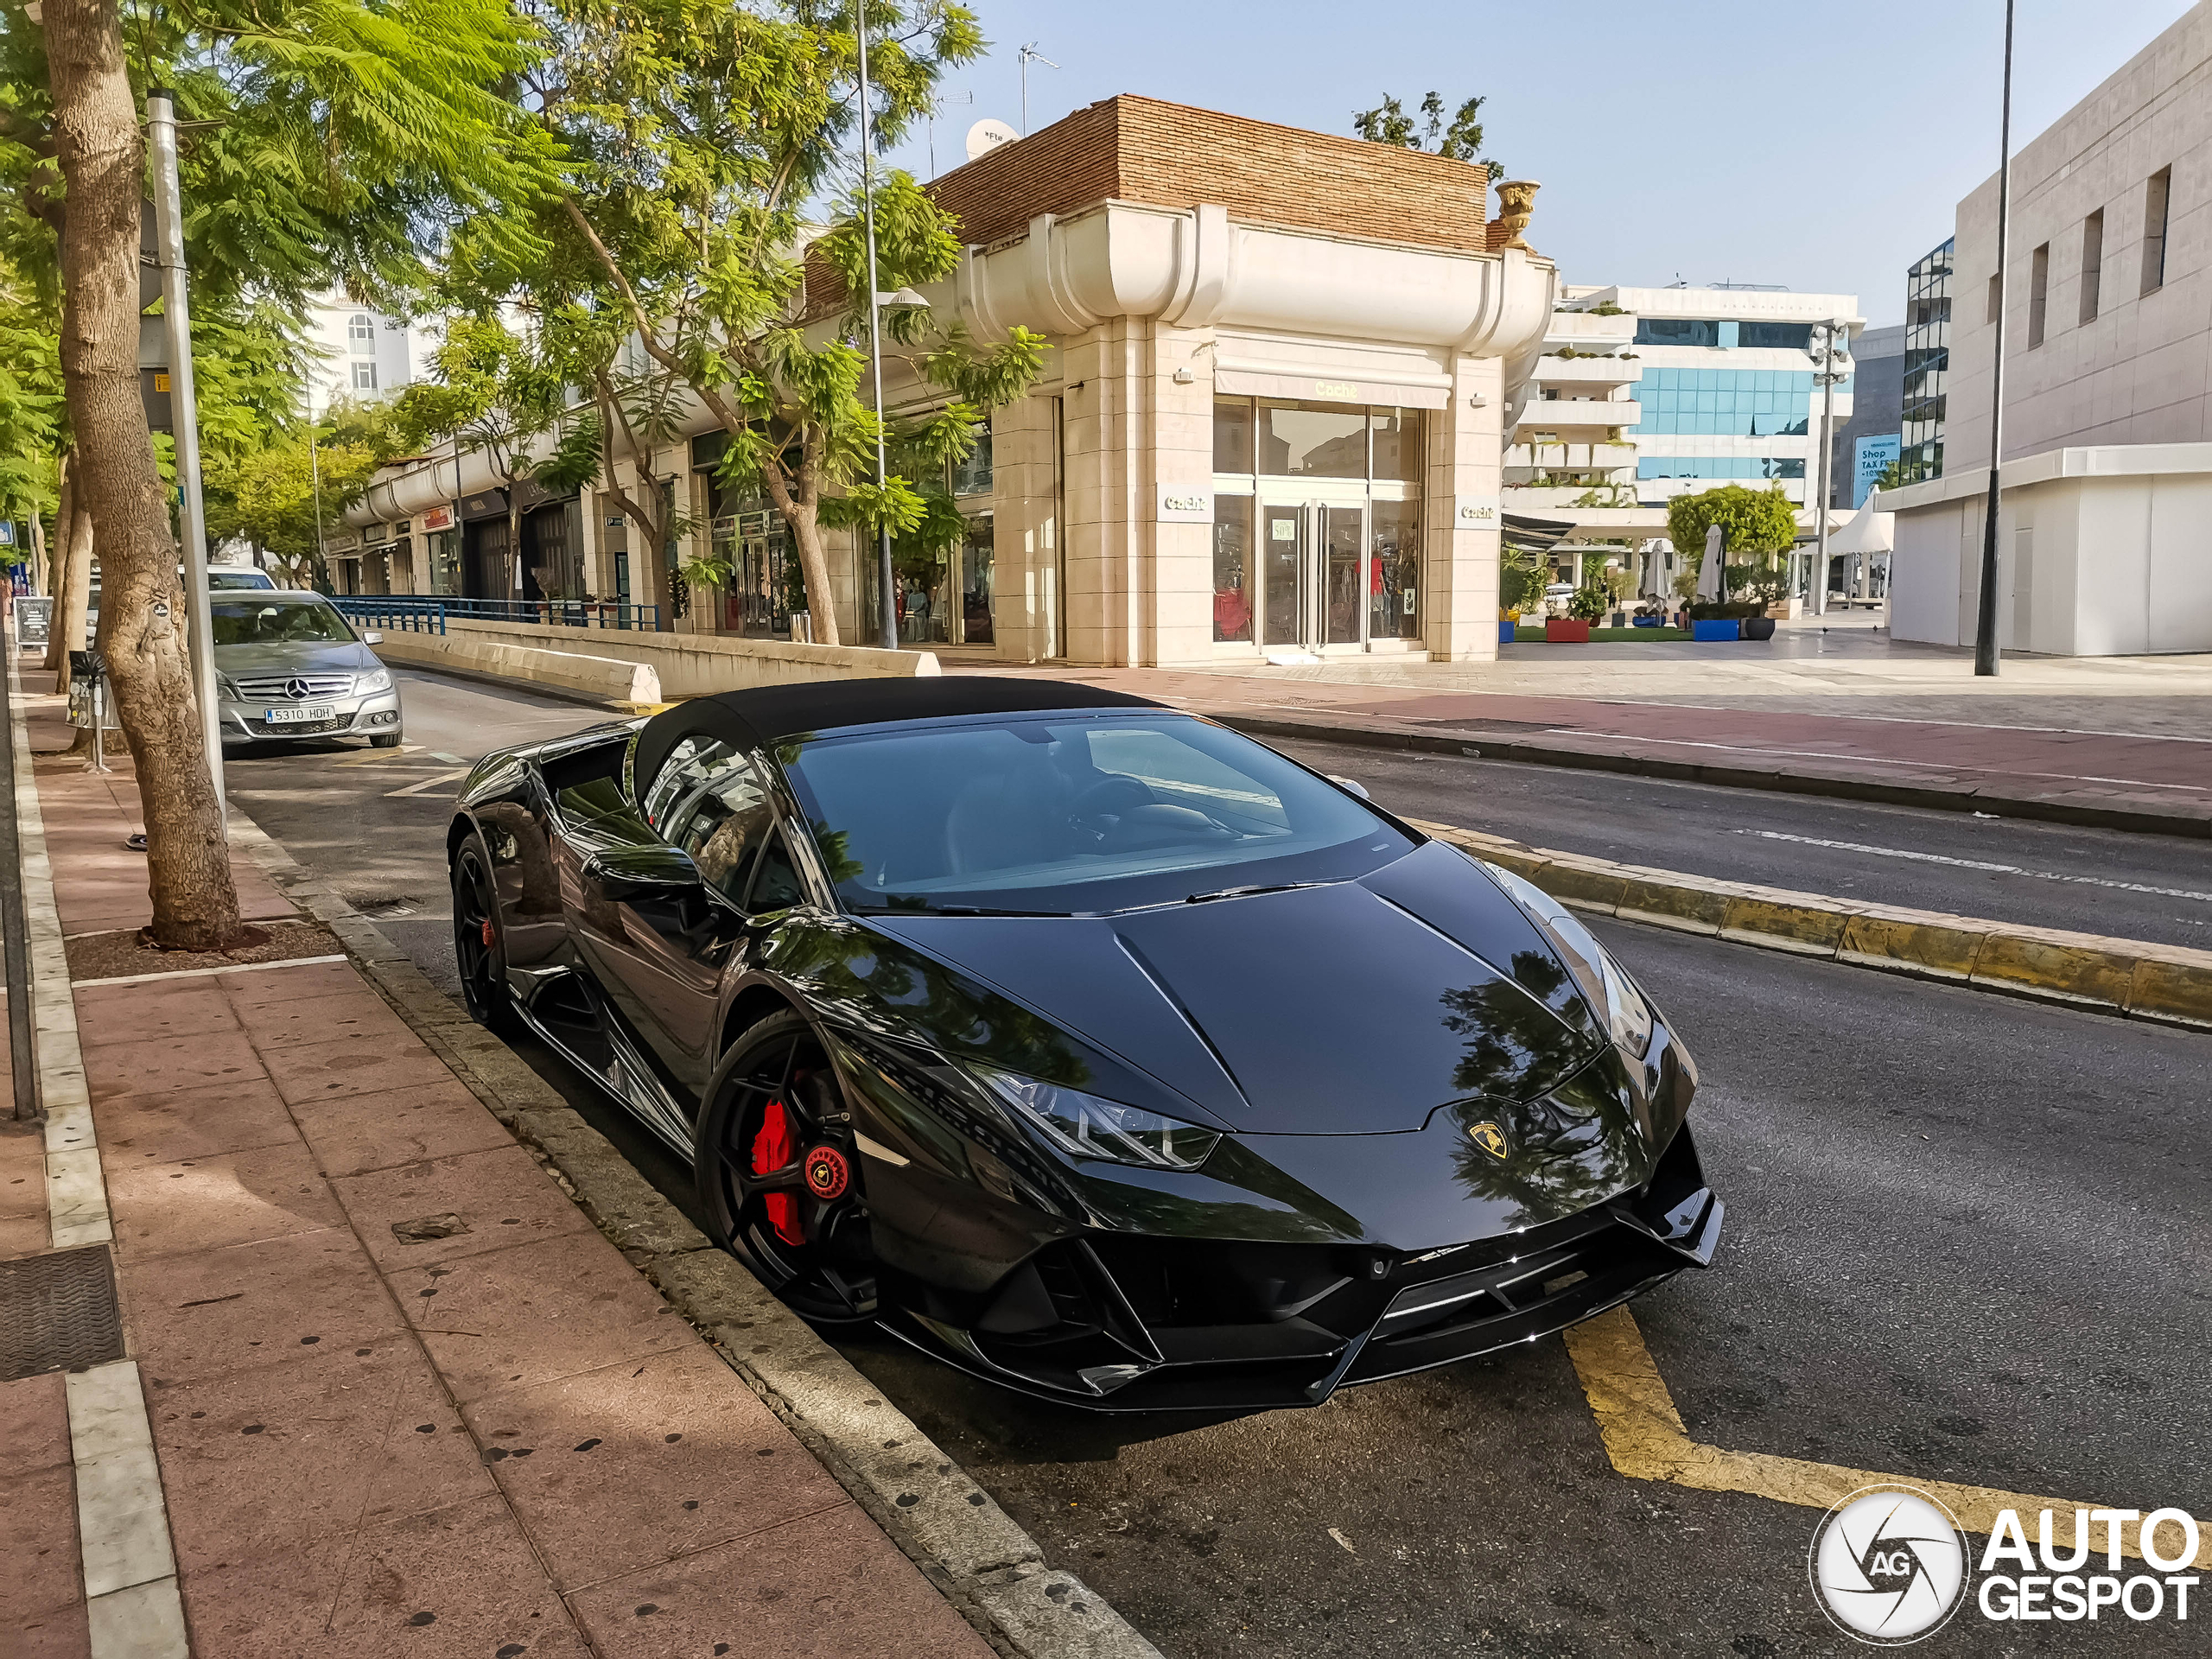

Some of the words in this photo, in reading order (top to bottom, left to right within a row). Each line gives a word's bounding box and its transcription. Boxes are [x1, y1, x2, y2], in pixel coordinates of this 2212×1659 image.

[1862, 450, 1885, 459] Shop
[1862, 460, 1878, 468] TAX
[276, 710, 303, 720] 5310
[309, 709, 329, 718] HDH
